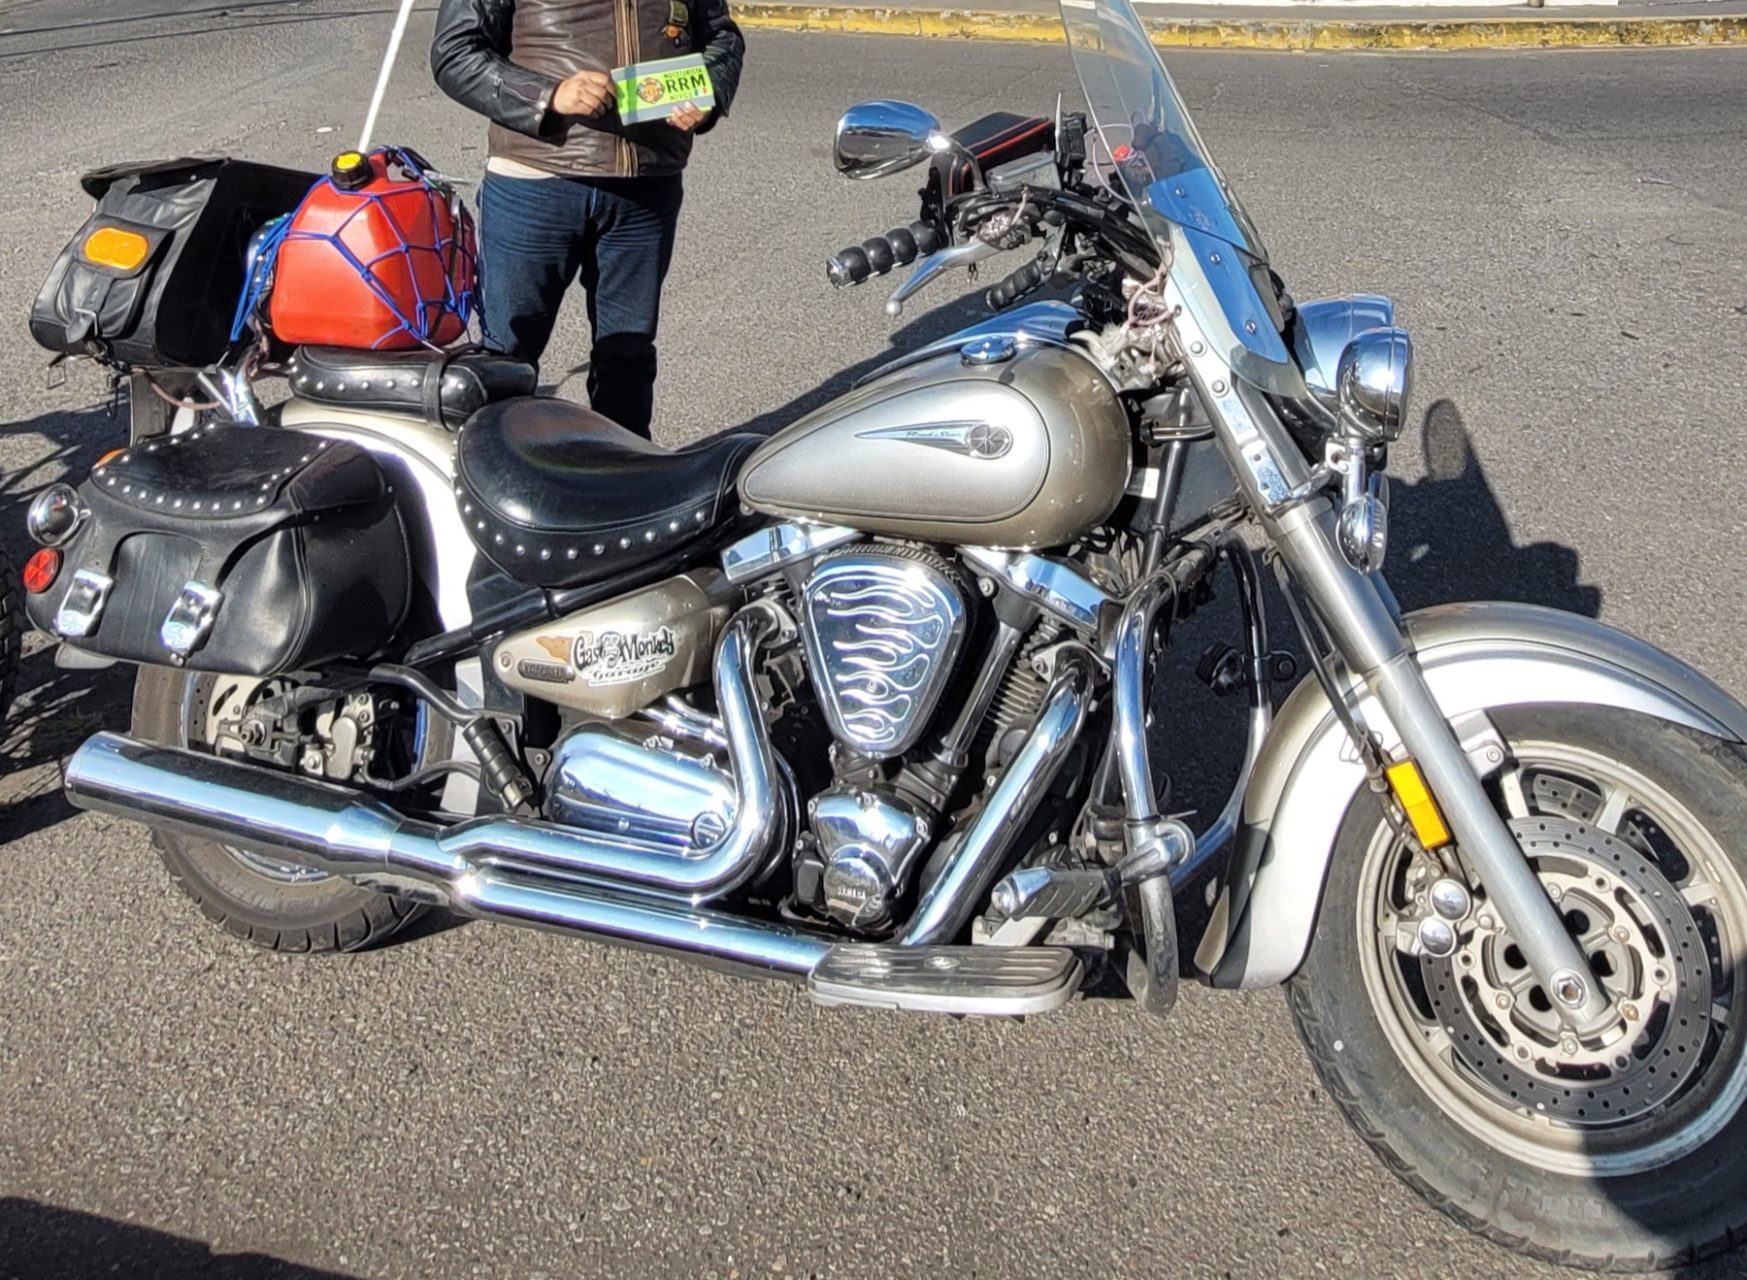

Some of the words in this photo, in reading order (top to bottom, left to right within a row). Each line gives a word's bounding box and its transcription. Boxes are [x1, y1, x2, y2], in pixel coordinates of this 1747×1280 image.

[665, 74, 706, 93] RRM
[574, 635, 600, 671] Gas
[619, 628, 675, 662] Monkey
